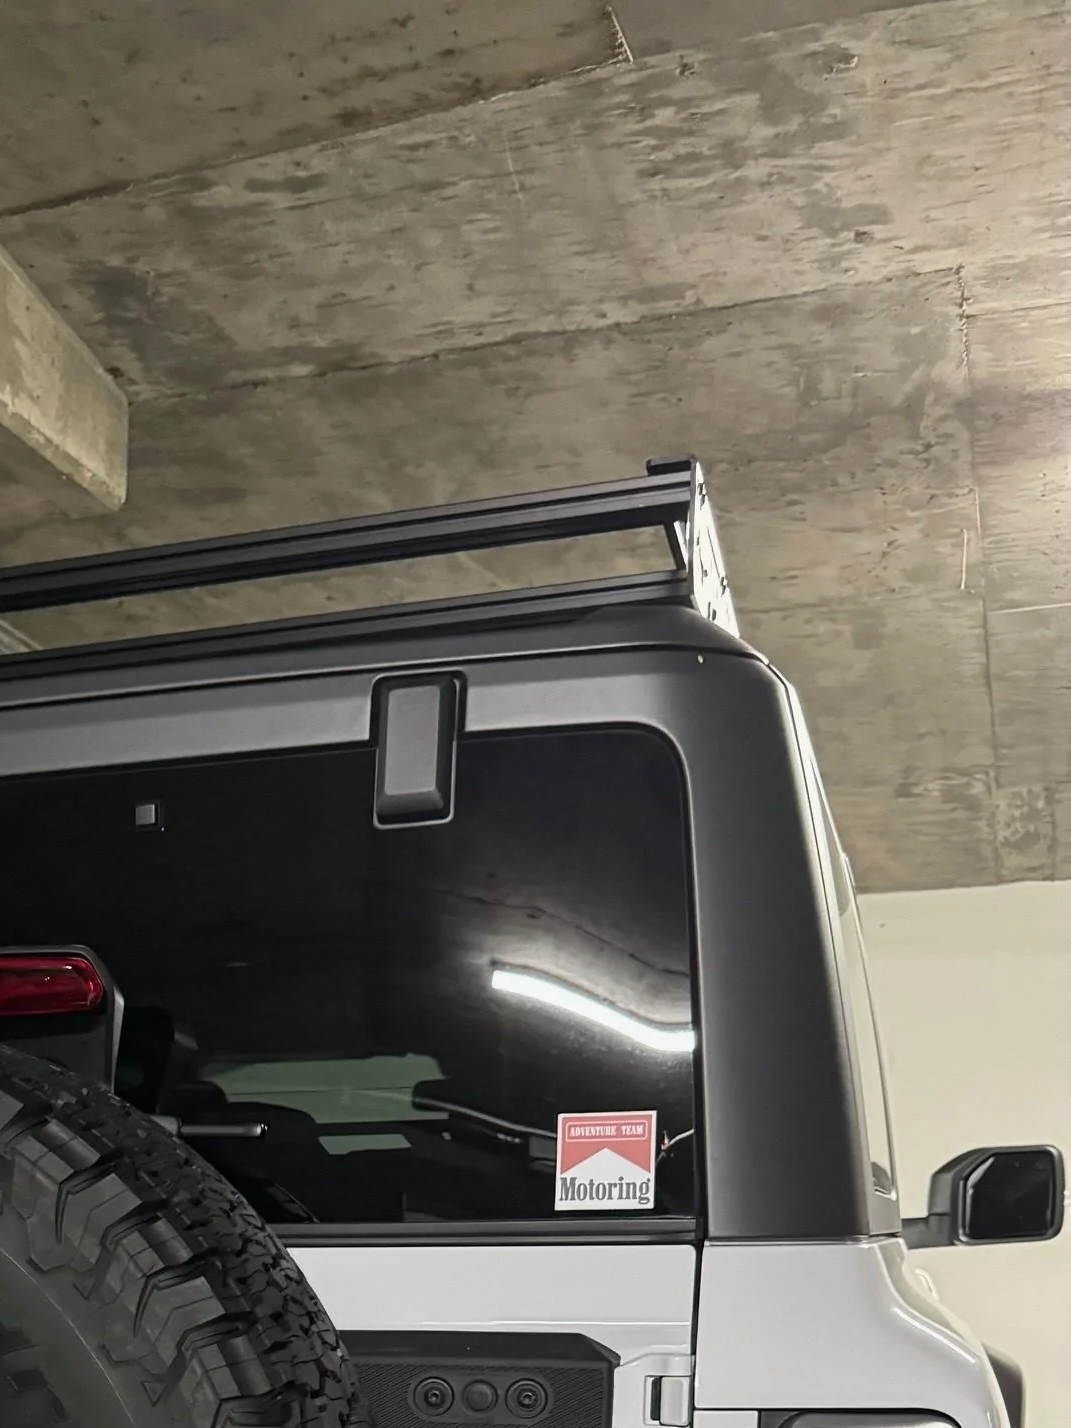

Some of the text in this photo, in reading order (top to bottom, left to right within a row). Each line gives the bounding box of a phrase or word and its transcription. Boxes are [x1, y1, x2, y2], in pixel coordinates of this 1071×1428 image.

[569, 1124, 644, 1137] ADVENTURE TEAM
[559, 1176, 651, 1205] Motoring
